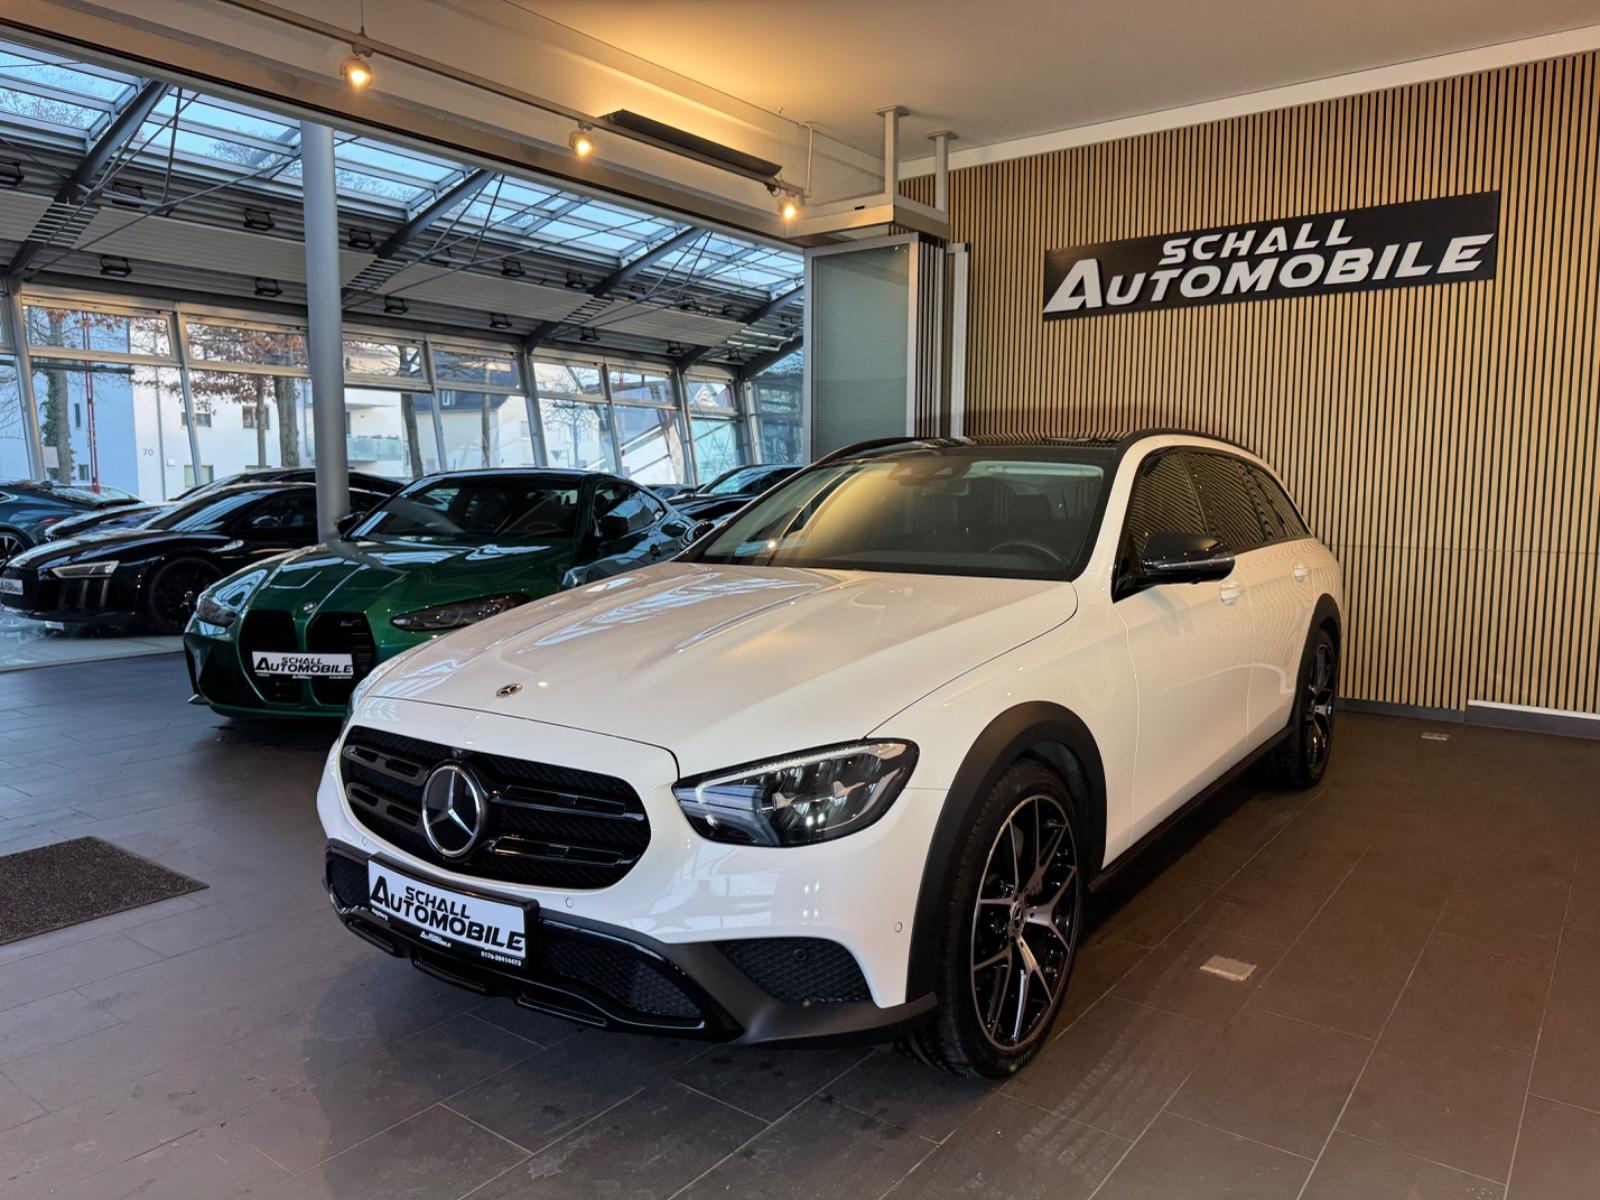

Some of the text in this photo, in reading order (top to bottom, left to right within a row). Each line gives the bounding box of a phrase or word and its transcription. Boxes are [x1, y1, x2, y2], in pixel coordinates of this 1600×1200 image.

[1158, 218, 1353, 266] SCHALL
[1042, 233, 1496, 313] AUTOMOBILE
[142, 447, 154, 457] 70
[255, 657, 353, 674] AUTOMOBILE
[281, 656, 323, 666] SCHALL
[370, 875, 526, 951] AUTOMOBILE
[405, 886, 471, 920] SCHALL
